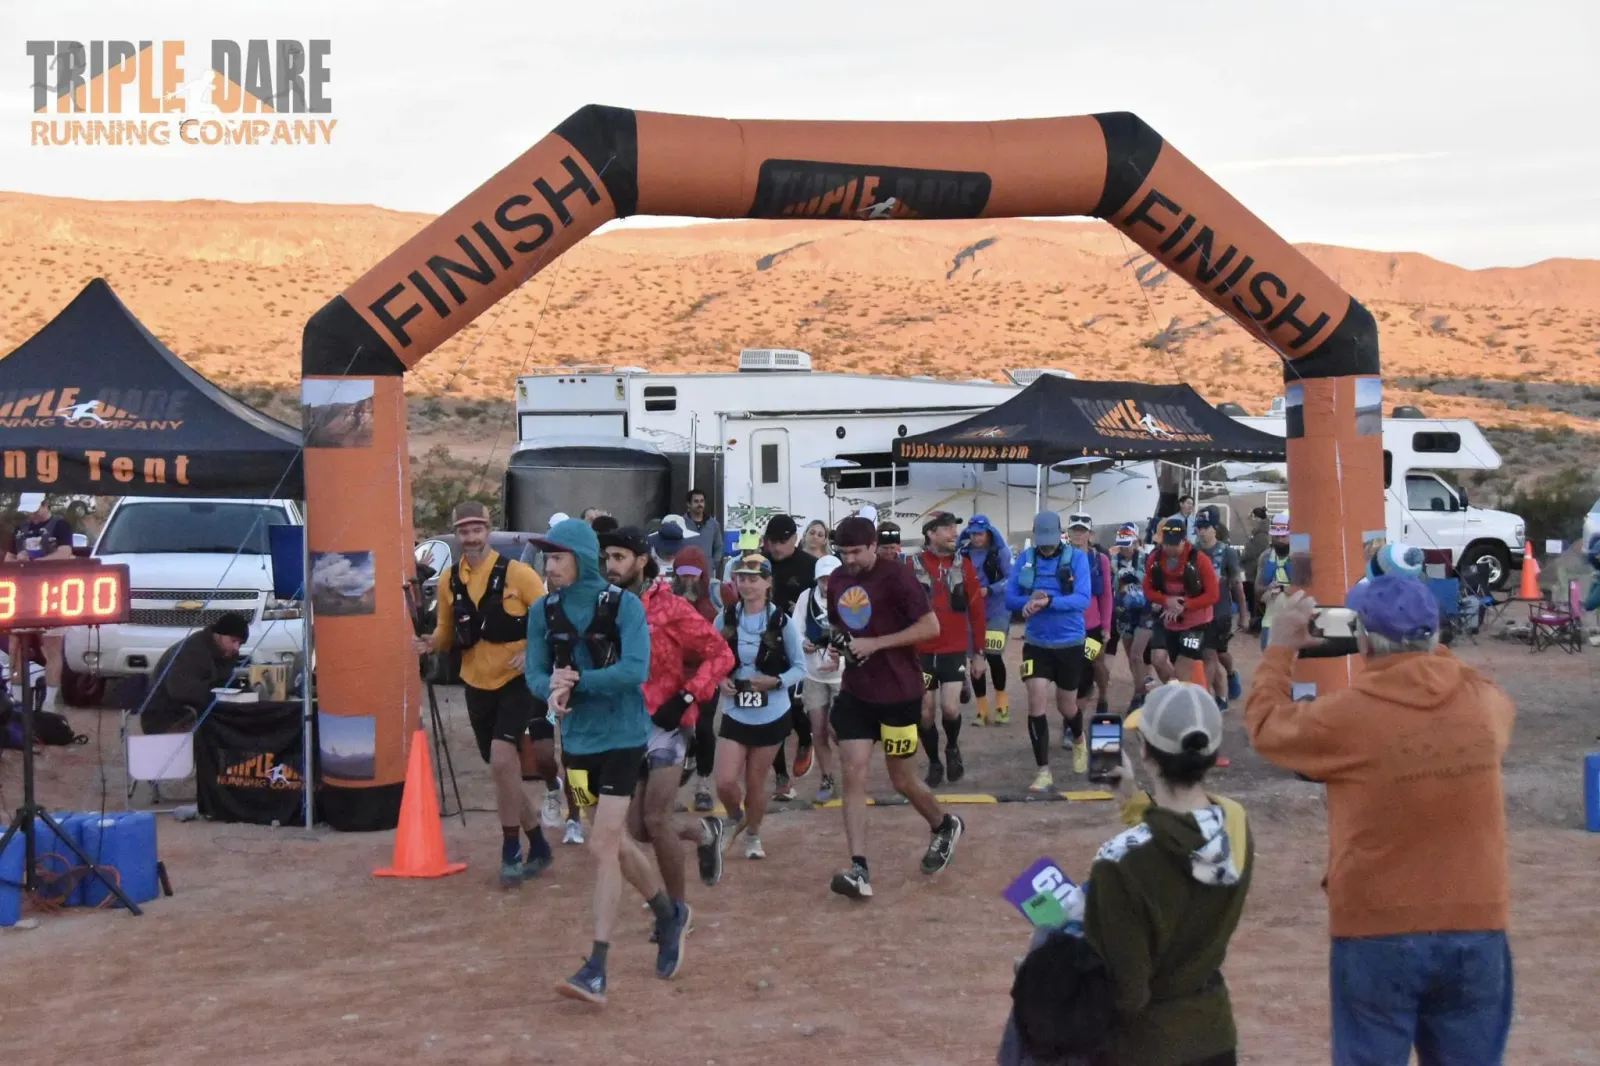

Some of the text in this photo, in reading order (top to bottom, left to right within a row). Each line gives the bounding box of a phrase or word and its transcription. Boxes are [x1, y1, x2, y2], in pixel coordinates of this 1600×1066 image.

[367, 155, 601, 350] FINISH
[1121, 188, 1331, 350] FINISH
[64, 419, 184, 431] COMPANY
[900, 442, 1030, 460] tripledareruns.com
[85, 450, 191, 485] Tent
[1183, 637, 1200, 649] 115
[737, 691, 762, 707] 123
[884, 738, 911, 753] 613
